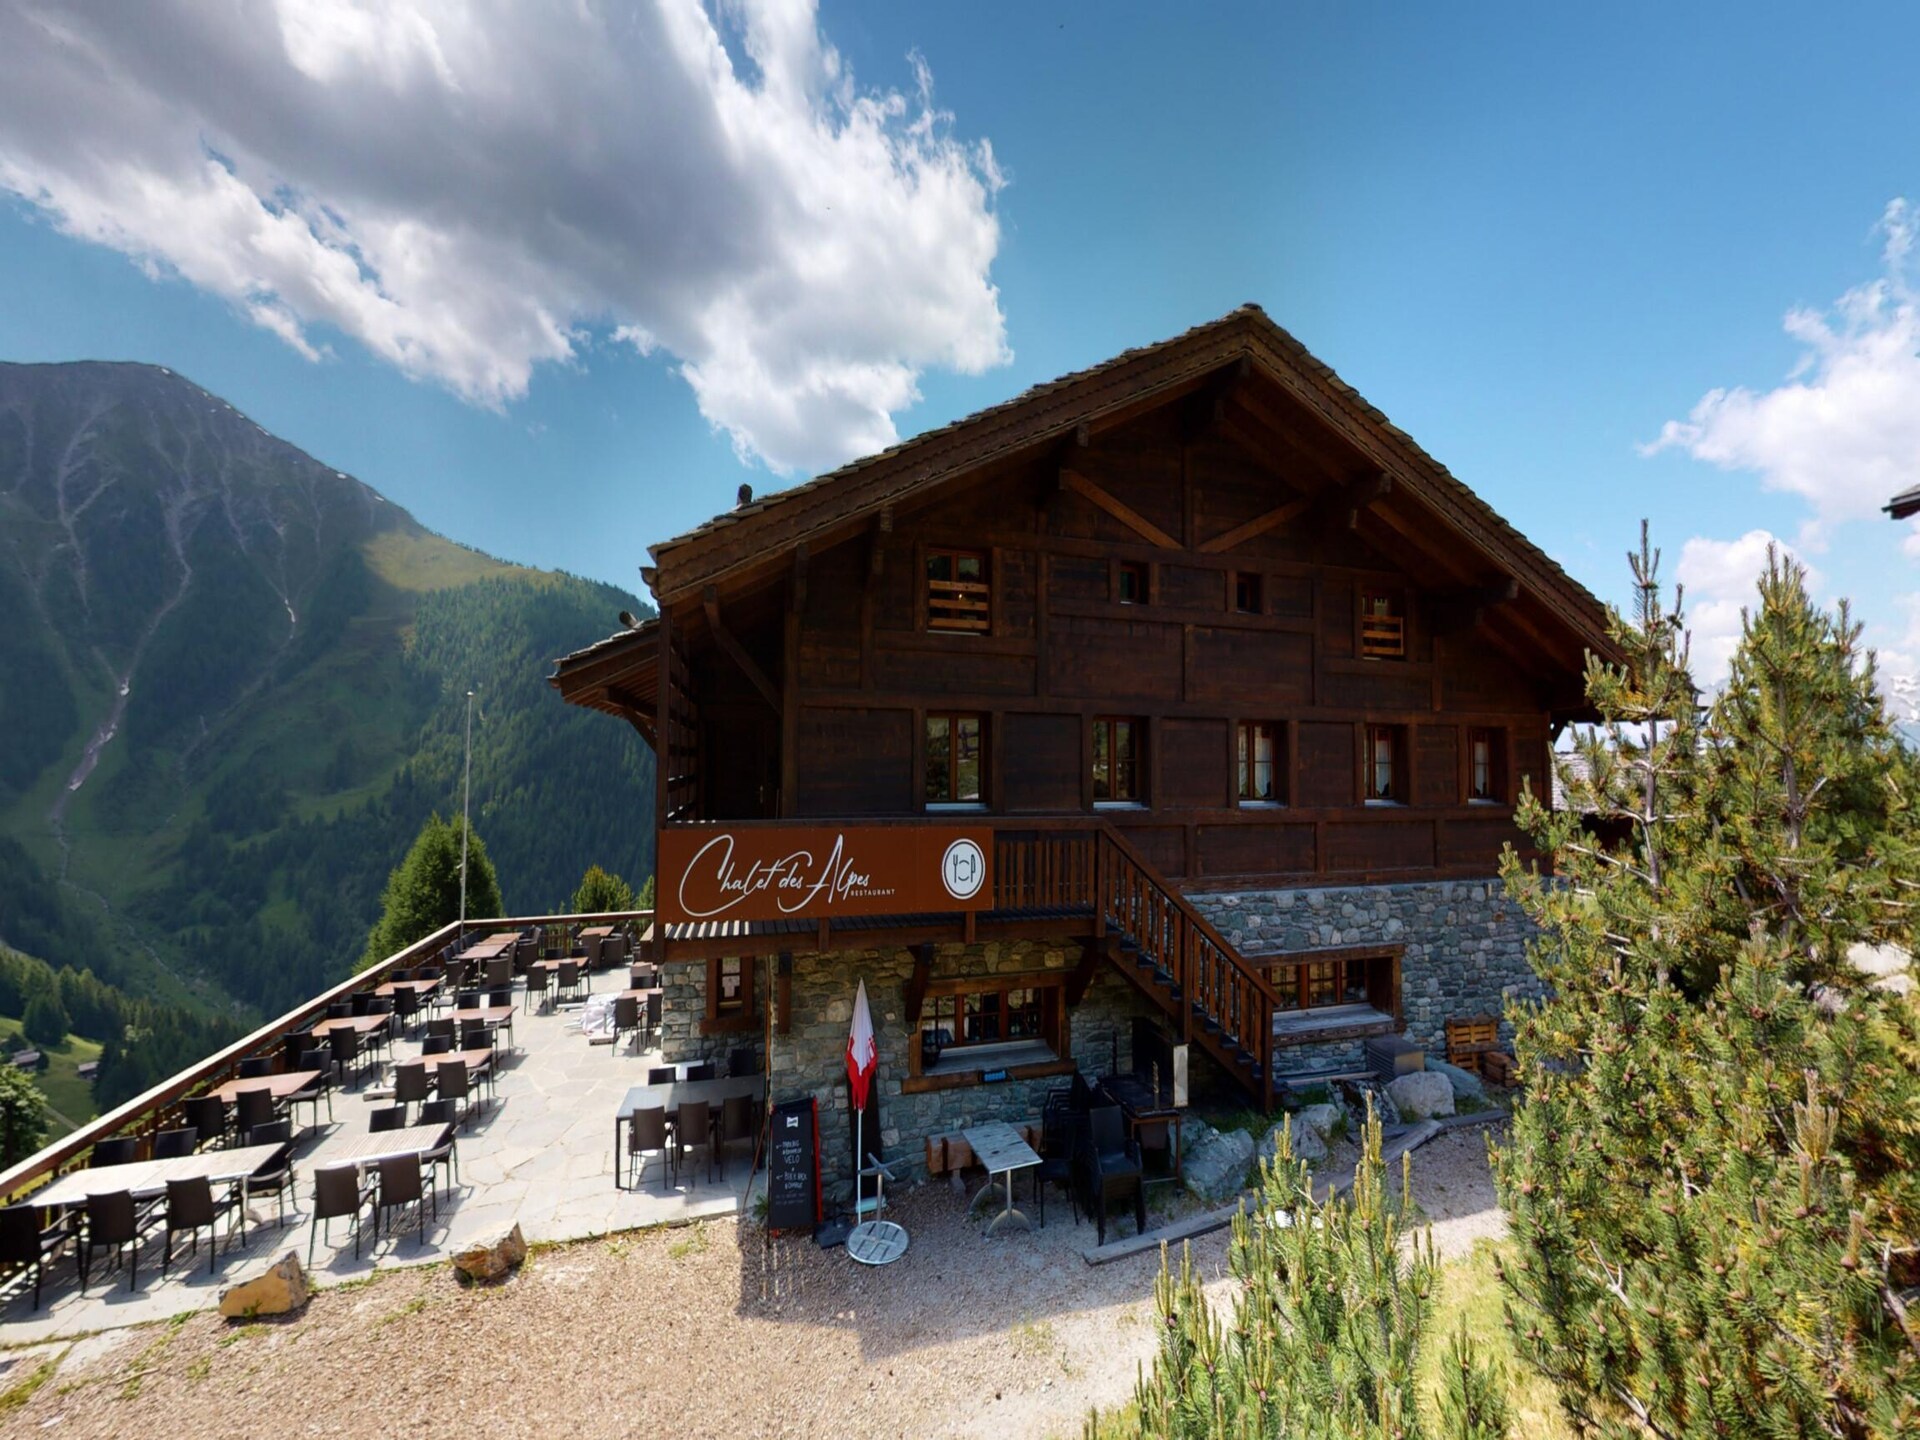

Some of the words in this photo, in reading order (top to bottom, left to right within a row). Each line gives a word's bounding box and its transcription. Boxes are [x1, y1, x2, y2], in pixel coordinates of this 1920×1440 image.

[679, 833, 786, 917] Chalet
[778, 833, 870, 913] Alpes
[778, 860, 805, 889] des
[850, 888, 896, 897] RESTAURANT
